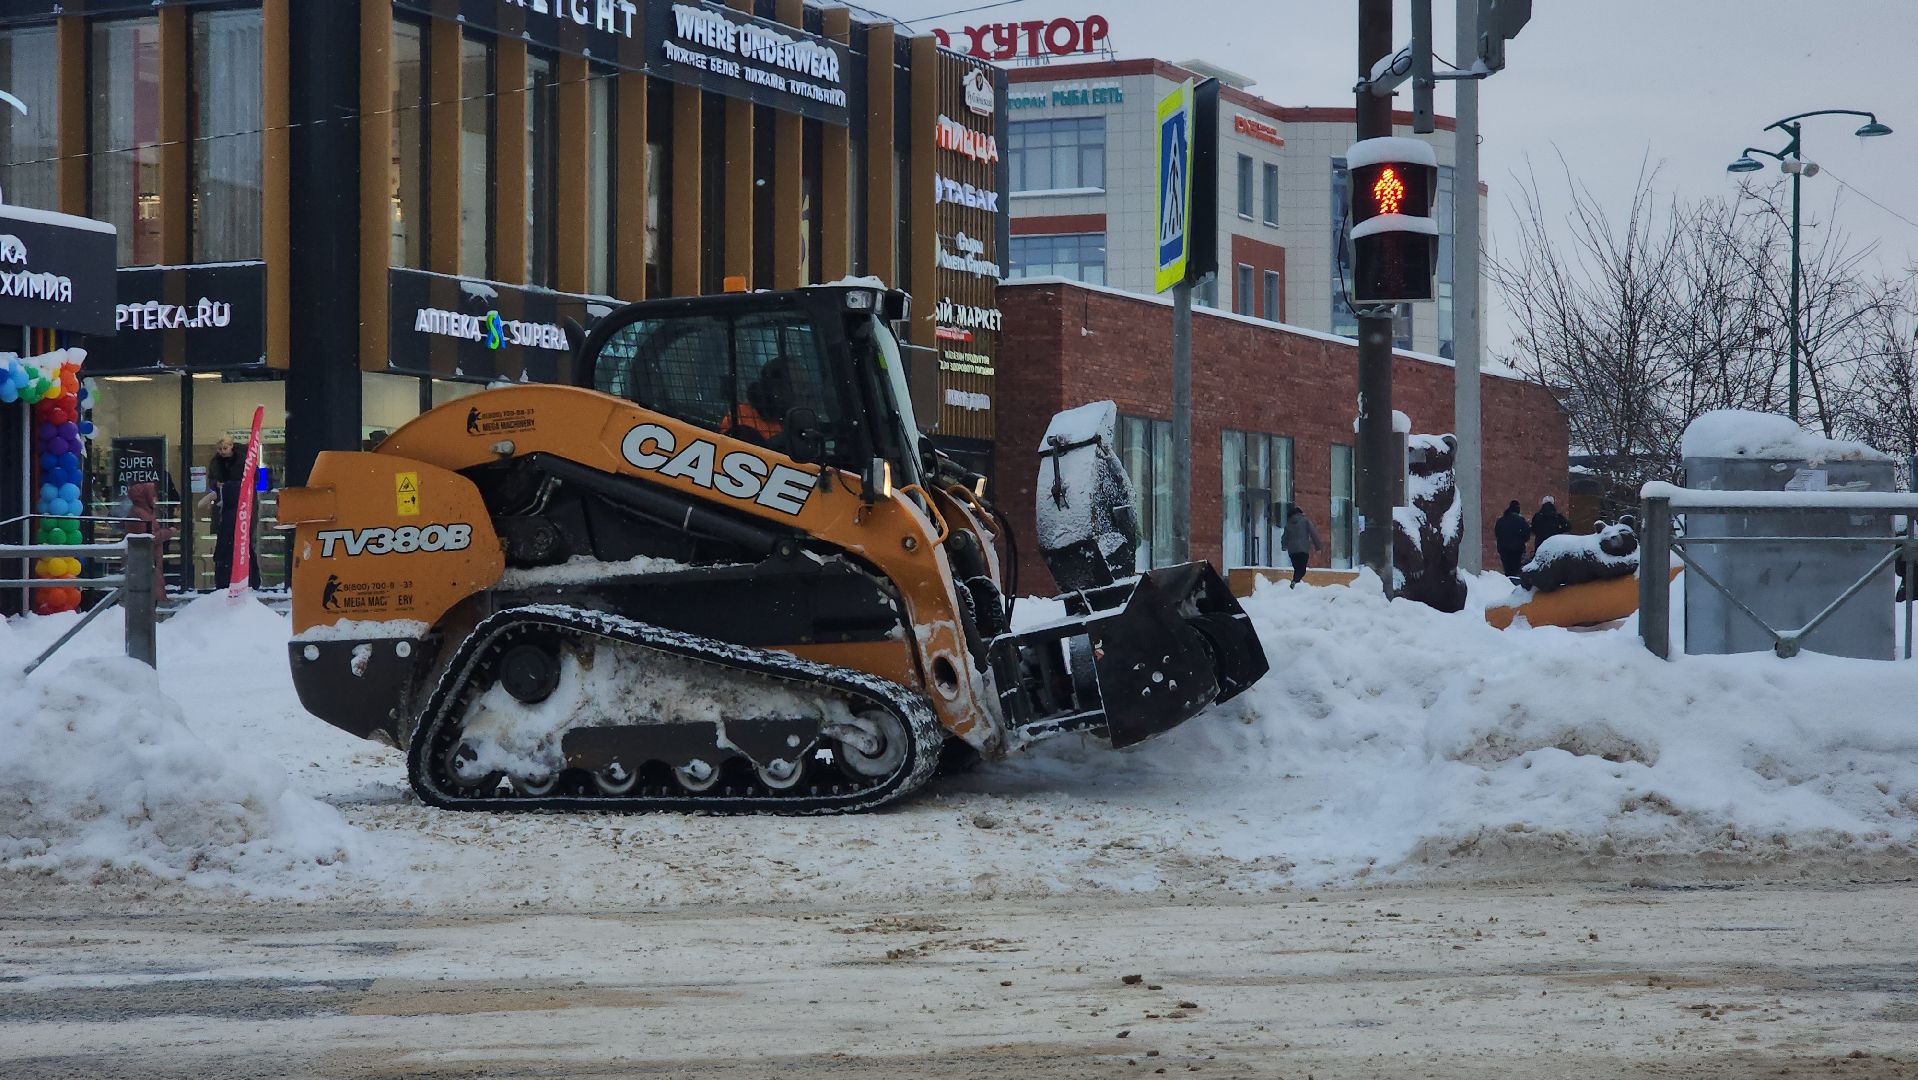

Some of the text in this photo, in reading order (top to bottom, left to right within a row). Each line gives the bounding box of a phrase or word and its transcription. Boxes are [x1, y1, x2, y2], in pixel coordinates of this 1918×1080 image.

[673, 7, 840, 82] WHERE UNDERWEAR
[964, 15, 1109, 60] ХУТОР
[665, 44, 847, 107] НИЖНЕЕ БЕЛЬЕ ПИЖАМЫ КУПАЛЬНИКИ
[0, 272, 72, 303] ХИМИЯ
[415, 309, 481, 342] АПТЕКА
[957, 304, 1002, 332] МАРКЕТ
[118, 471, 160, 483] APTEKA
[119, 456, 154, 469] SUPER
[621, 423, 818, 516] CASE
[316, 523, 473, 558] TV380B
[343, 597, 365, 608] MEGA
